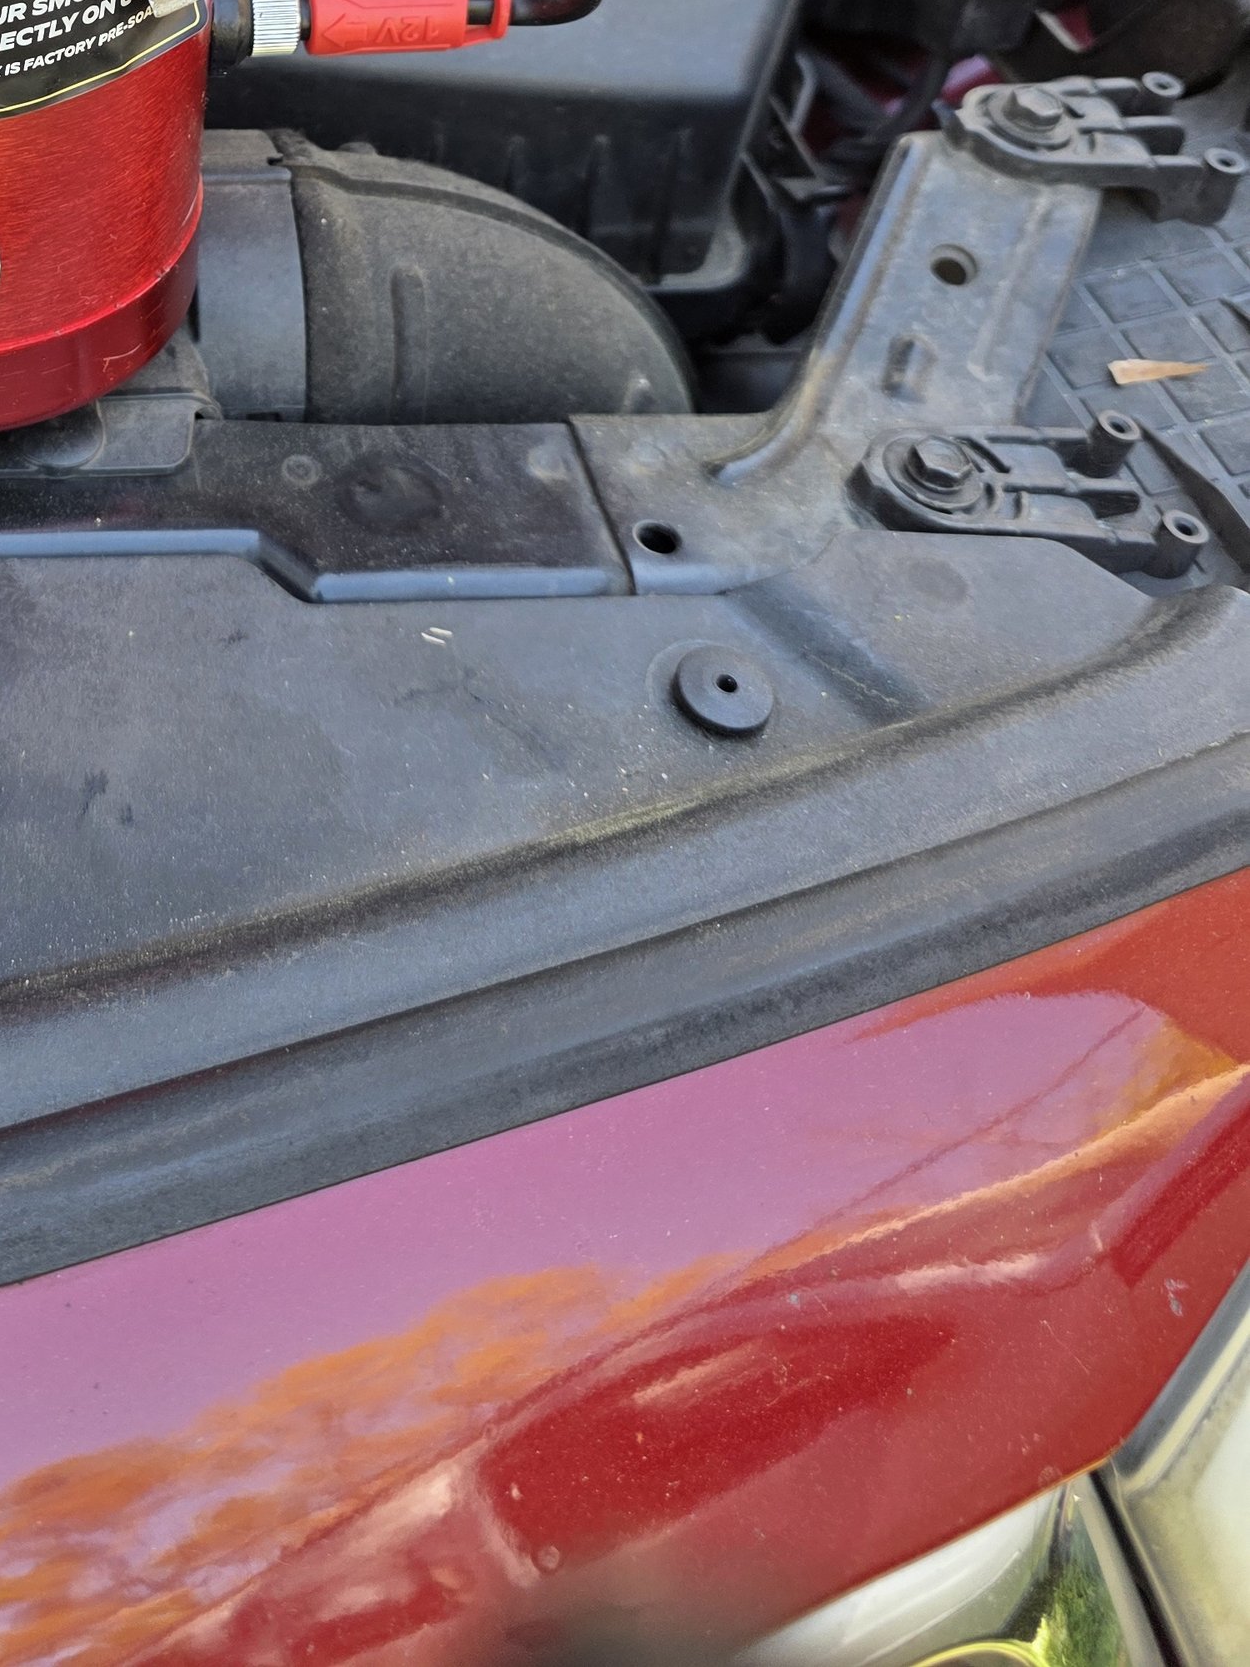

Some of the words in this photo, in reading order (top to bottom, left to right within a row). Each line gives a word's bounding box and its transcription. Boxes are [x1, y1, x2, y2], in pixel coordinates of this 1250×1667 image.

[5, 61, 21, 76] IS
[23, 36, 96, 71] FACTORY
[97, 5, 153, 47] PRE-SOA
